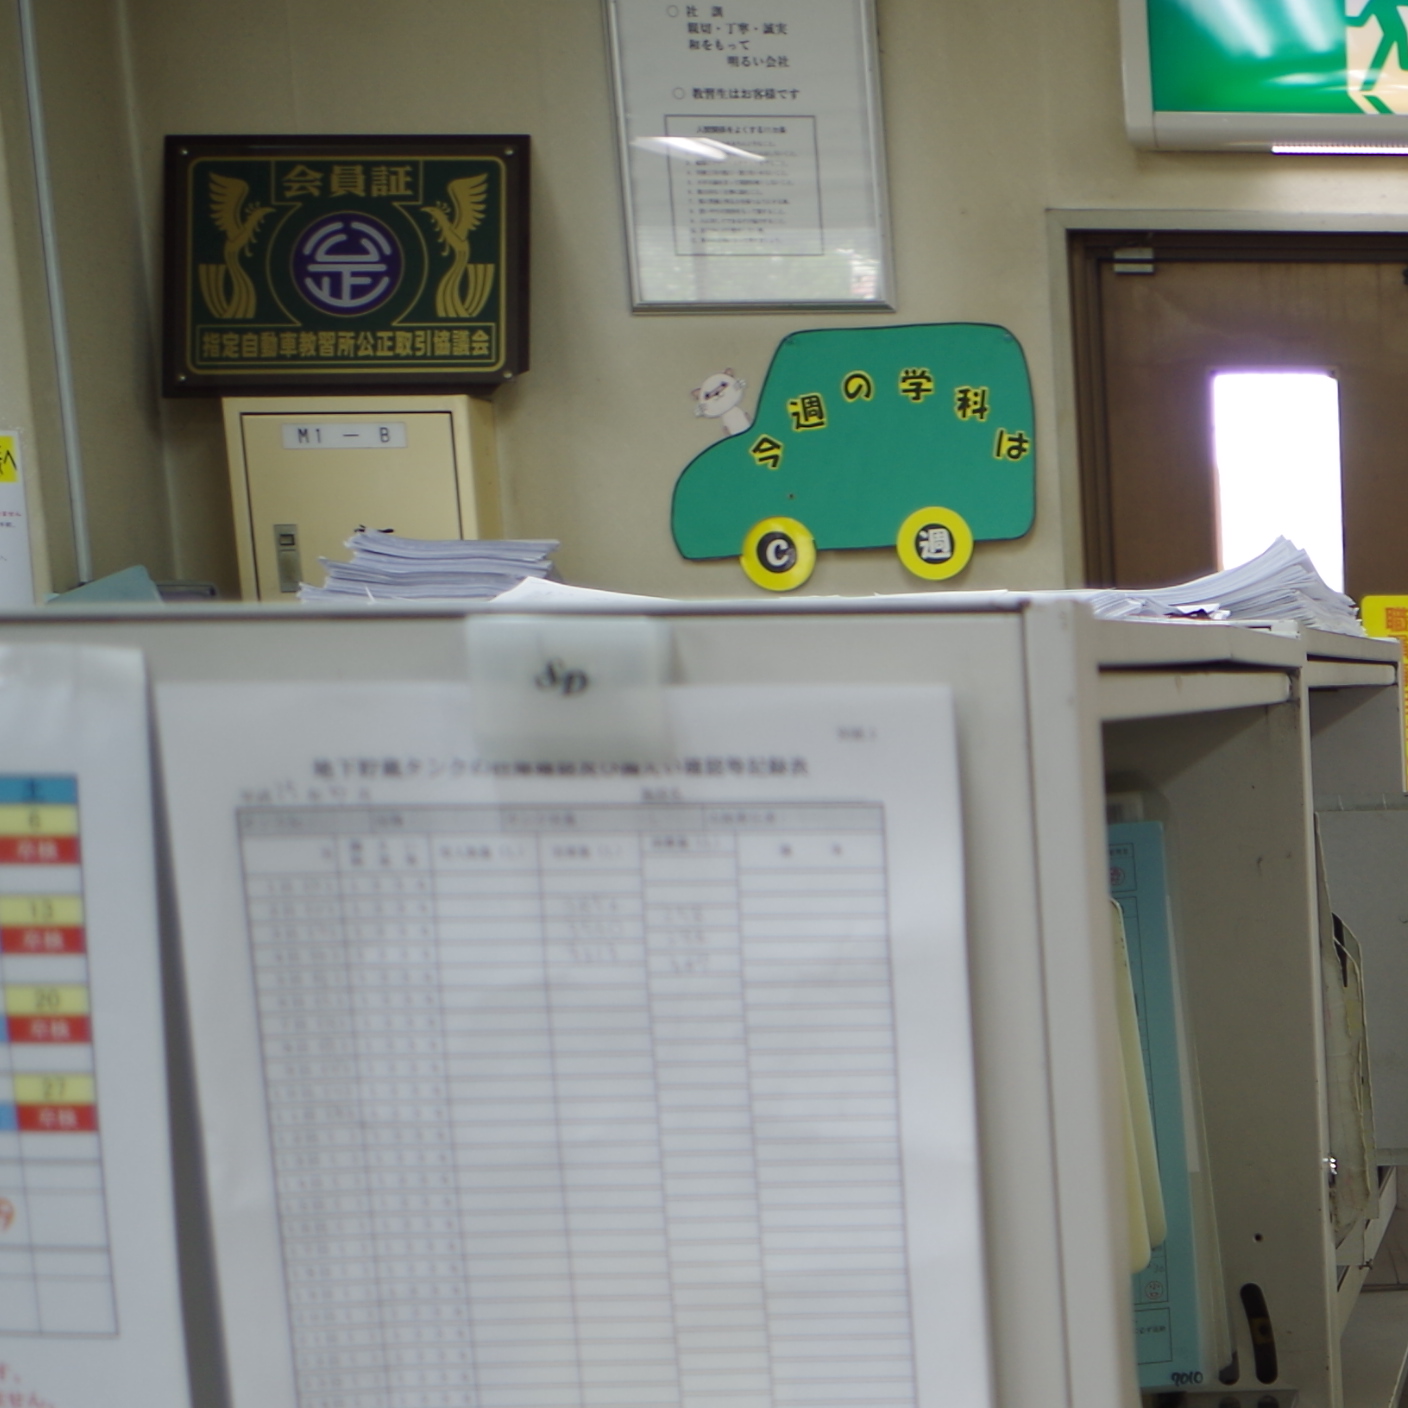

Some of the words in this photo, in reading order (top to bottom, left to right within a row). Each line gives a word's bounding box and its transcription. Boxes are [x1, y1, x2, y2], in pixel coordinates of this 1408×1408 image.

[727, 56, 789, 68] 明るい会社
[692, 88, 800, 100] 教習生はお客様です
[282, 165, 413, 198] 会員証
[203, 330, 490, 358] 指定自動車教習所公正取引協議会
[750, 369, 1030, 470] 今週の学科は
[379, 427, 391, 445] B
[918, 528, 952, 561] 週
